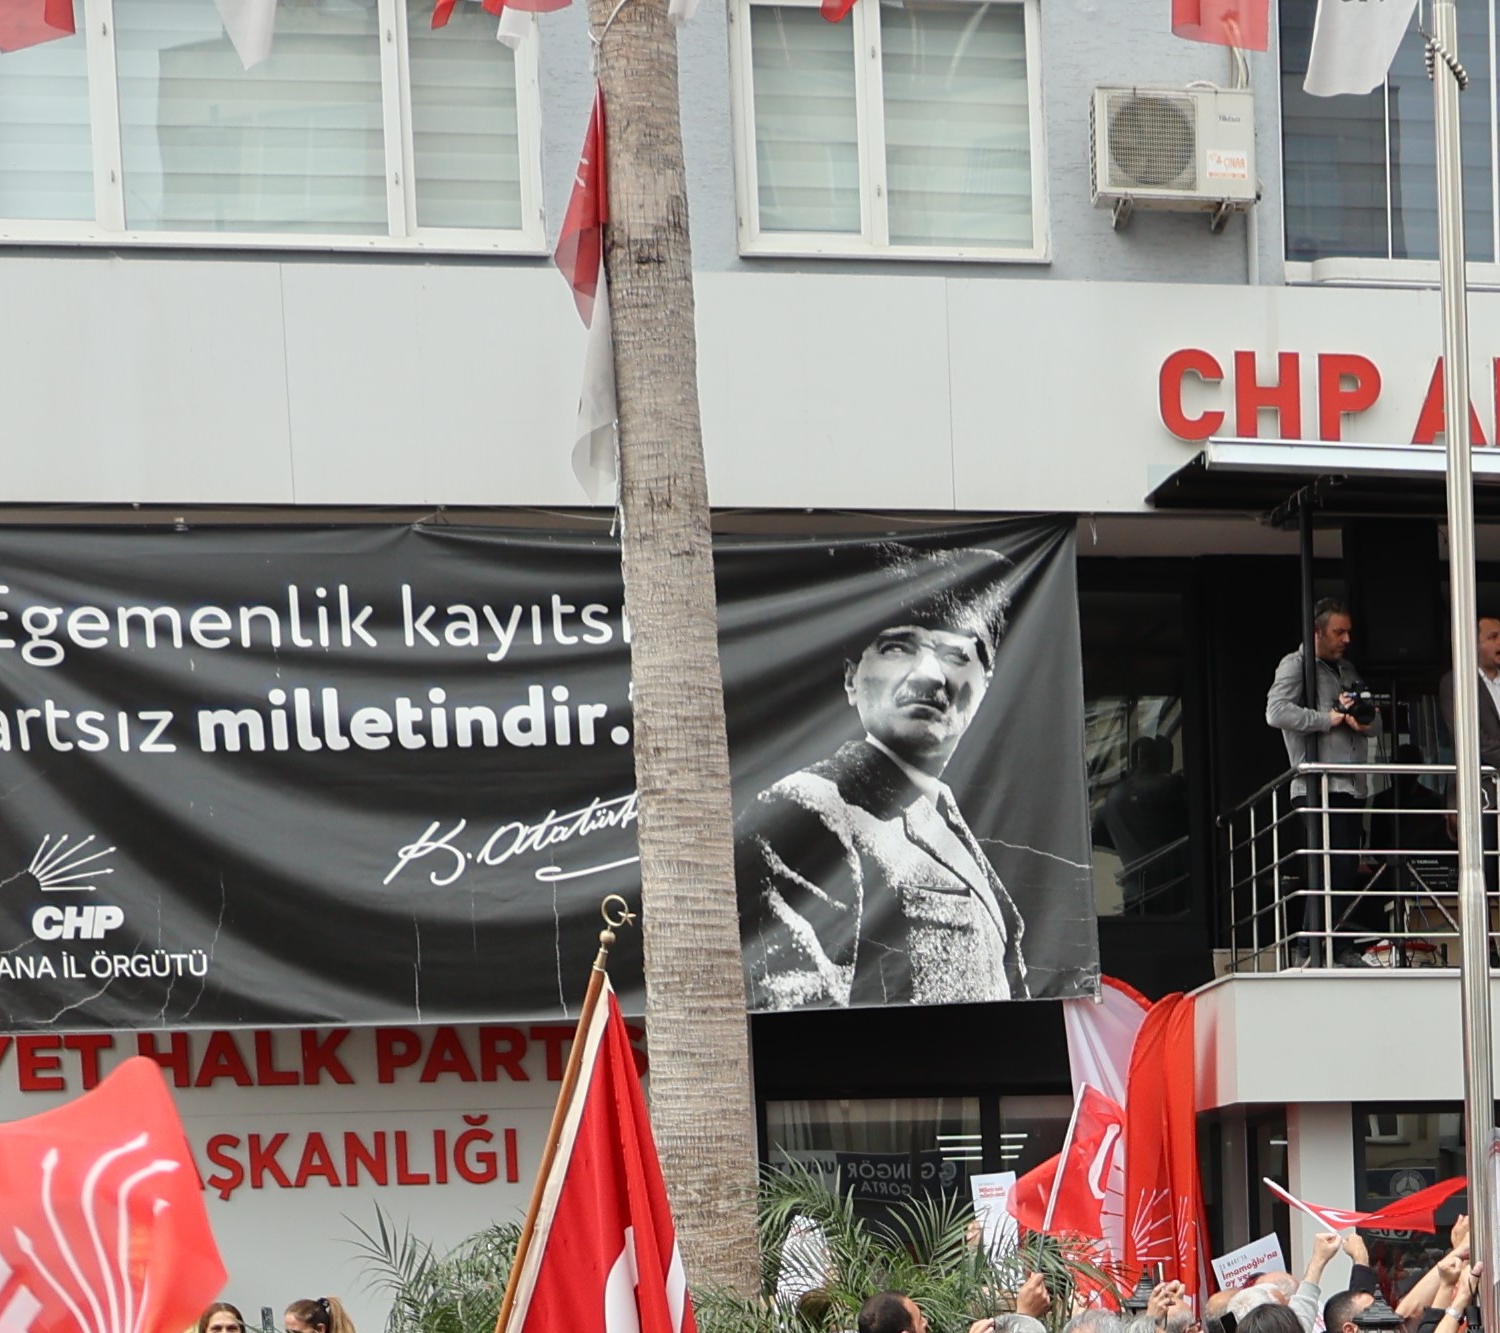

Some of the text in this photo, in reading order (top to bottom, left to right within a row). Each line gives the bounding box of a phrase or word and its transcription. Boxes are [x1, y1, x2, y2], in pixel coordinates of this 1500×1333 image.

[1158, 348, 1382, 442] CHP
[30, 905, 124, 940] CHP
[61, 947, 85, 980] İL
[90, 945, 209, 978] ÖRGÜTÜ
[137, 1028, 355, 1088] HALK
